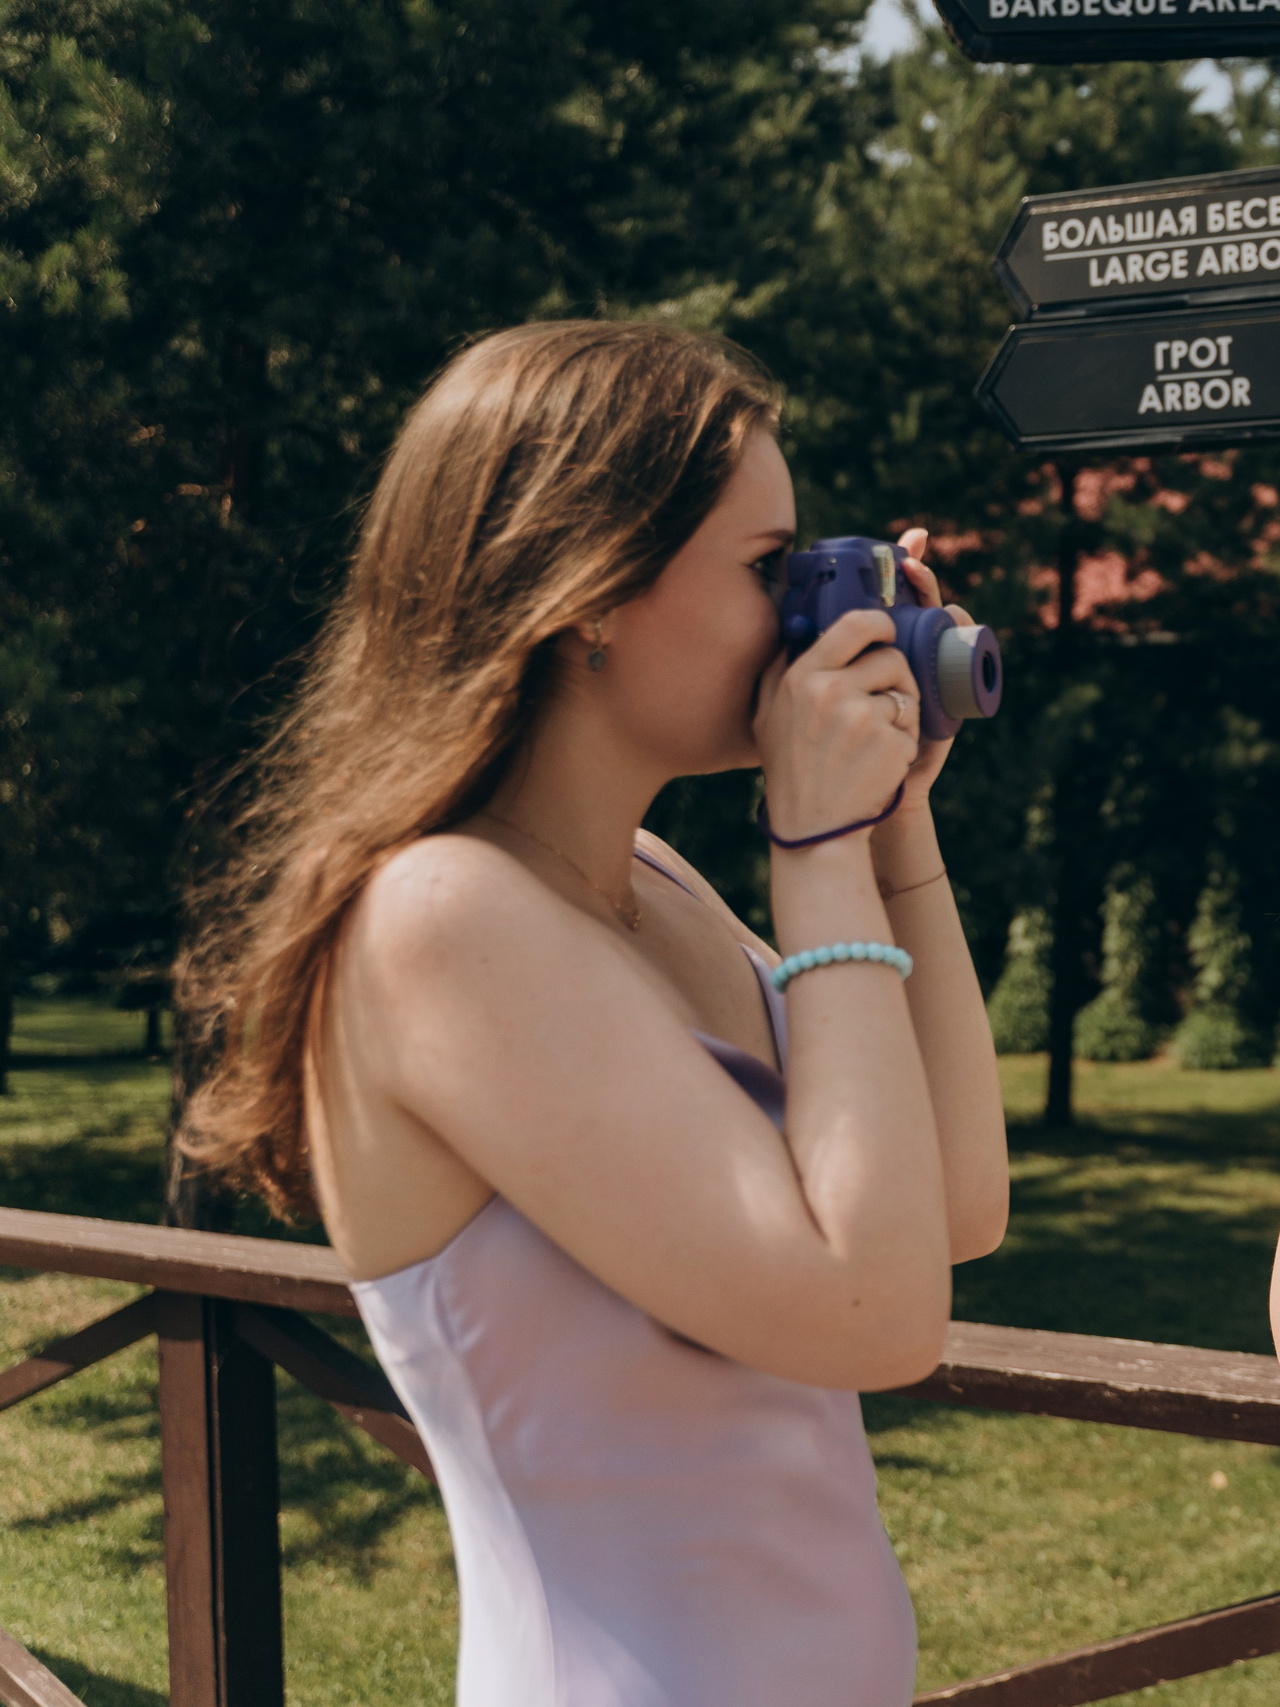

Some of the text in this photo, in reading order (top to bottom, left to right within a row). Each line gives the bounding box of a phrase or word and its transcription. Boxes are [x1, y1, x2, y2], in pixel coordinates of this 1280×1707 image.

[1042, 205, 1198, 251] БОЛЬШАЯ
[1089, 249, 1188, 287] LARGE
[1154, 336, 1233, 371] ГРОТ
[1138, 376, 1252, 415] ARBOR
